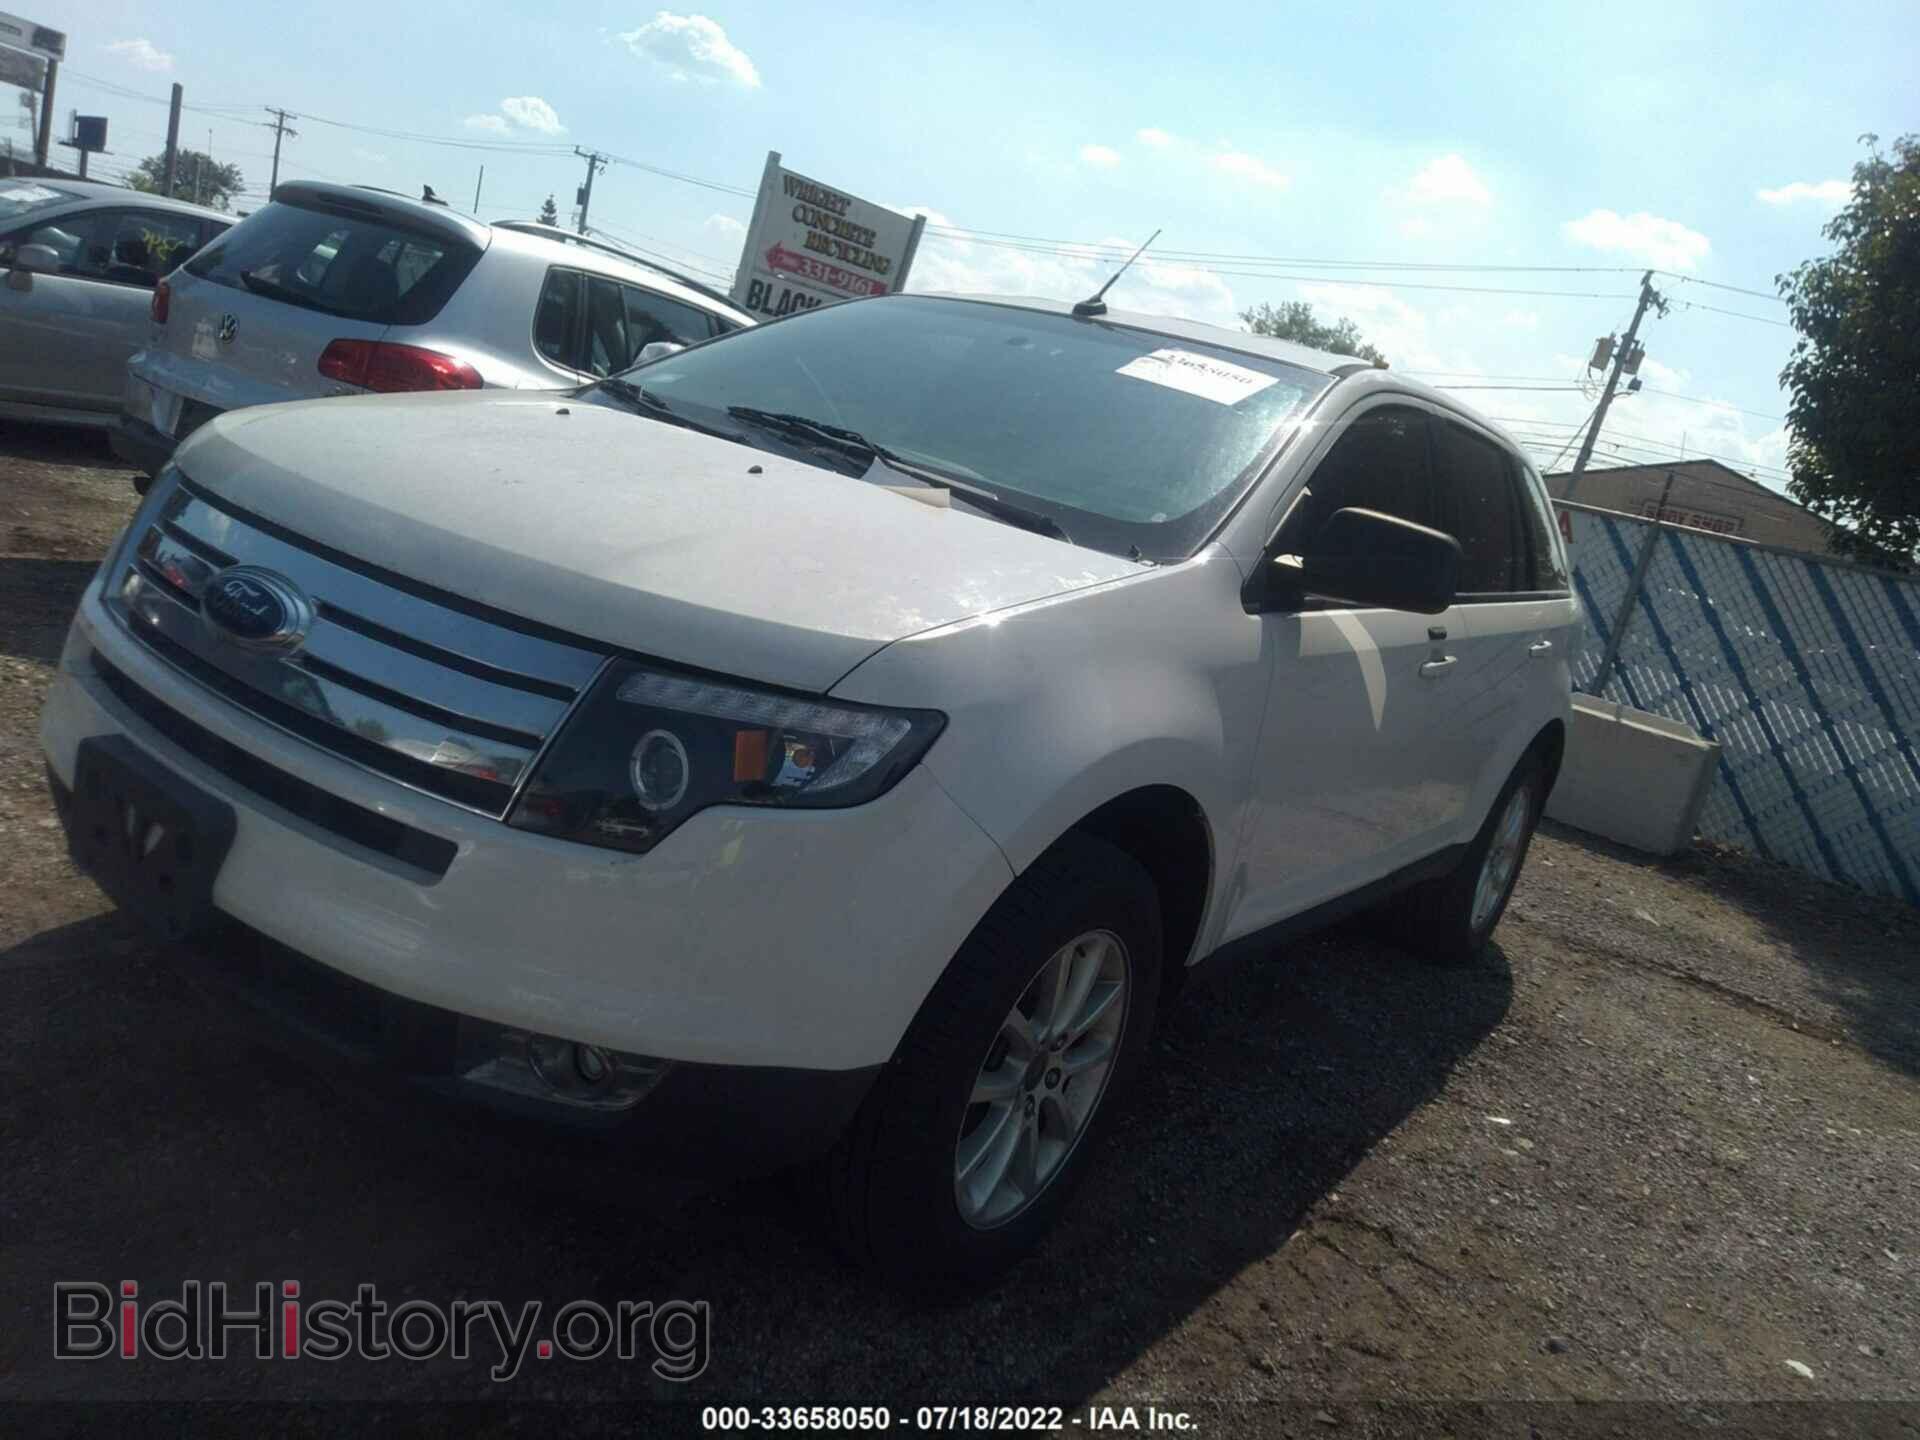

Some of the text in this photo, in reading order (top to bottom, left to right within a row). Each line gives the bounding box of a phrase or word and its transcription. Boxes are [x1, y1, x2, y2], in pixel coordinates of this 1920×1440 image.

[792, 205, 877, 249] CONCRETE
[803, 231, 891, 275] RECYCLING
[799, 258, 874, 296] 331-9161
